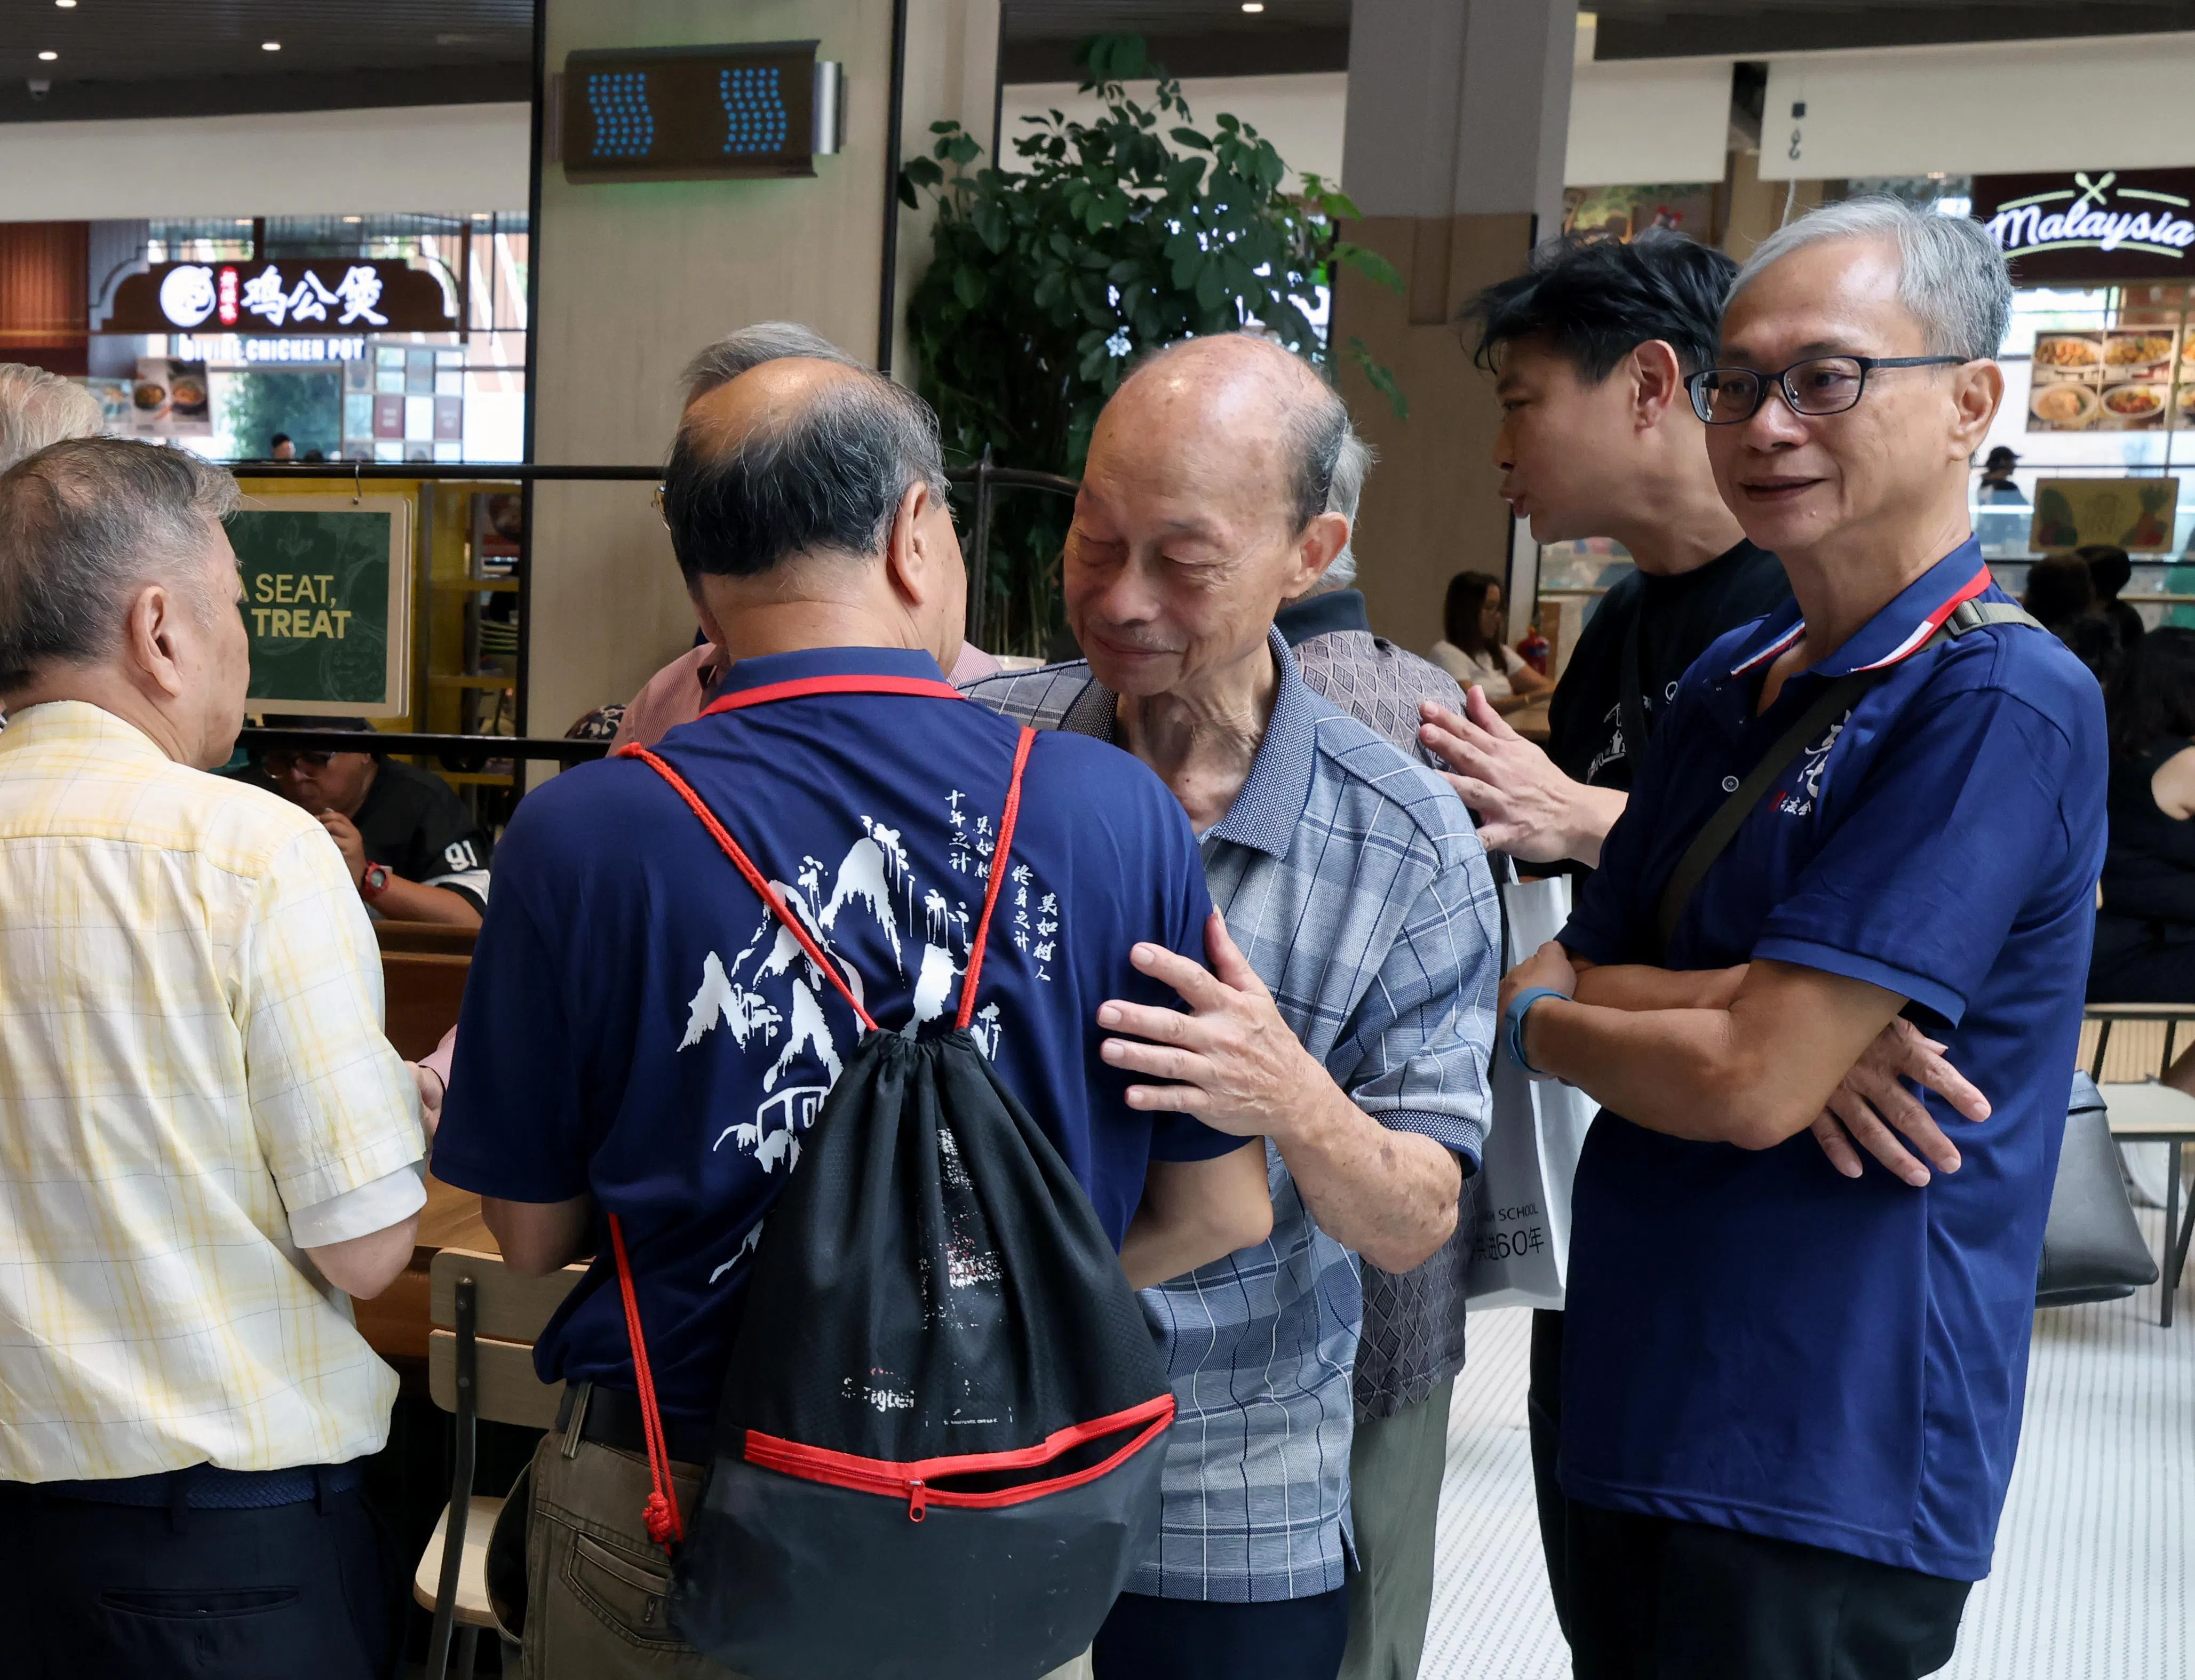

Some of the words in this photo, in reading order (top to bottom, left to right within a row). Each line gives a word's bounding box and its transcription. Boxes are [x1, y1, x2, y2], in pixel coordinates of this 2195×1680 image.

[1984, 201, 2195, 251] Malaysia
[240, 265, 389, 327] 鸡公煲
[246, 338, 324, 361] CHICKEN
[328, 338, 364, 361] POT
[255, 573, 337, 609] SEAT,
[251, 608, 352, 639] TREAT
[945, 789, 972, 874] 十年之计
[444, 840, 478, 872] 91
[1498, 1203, 1538, 1221] SCHOOL
